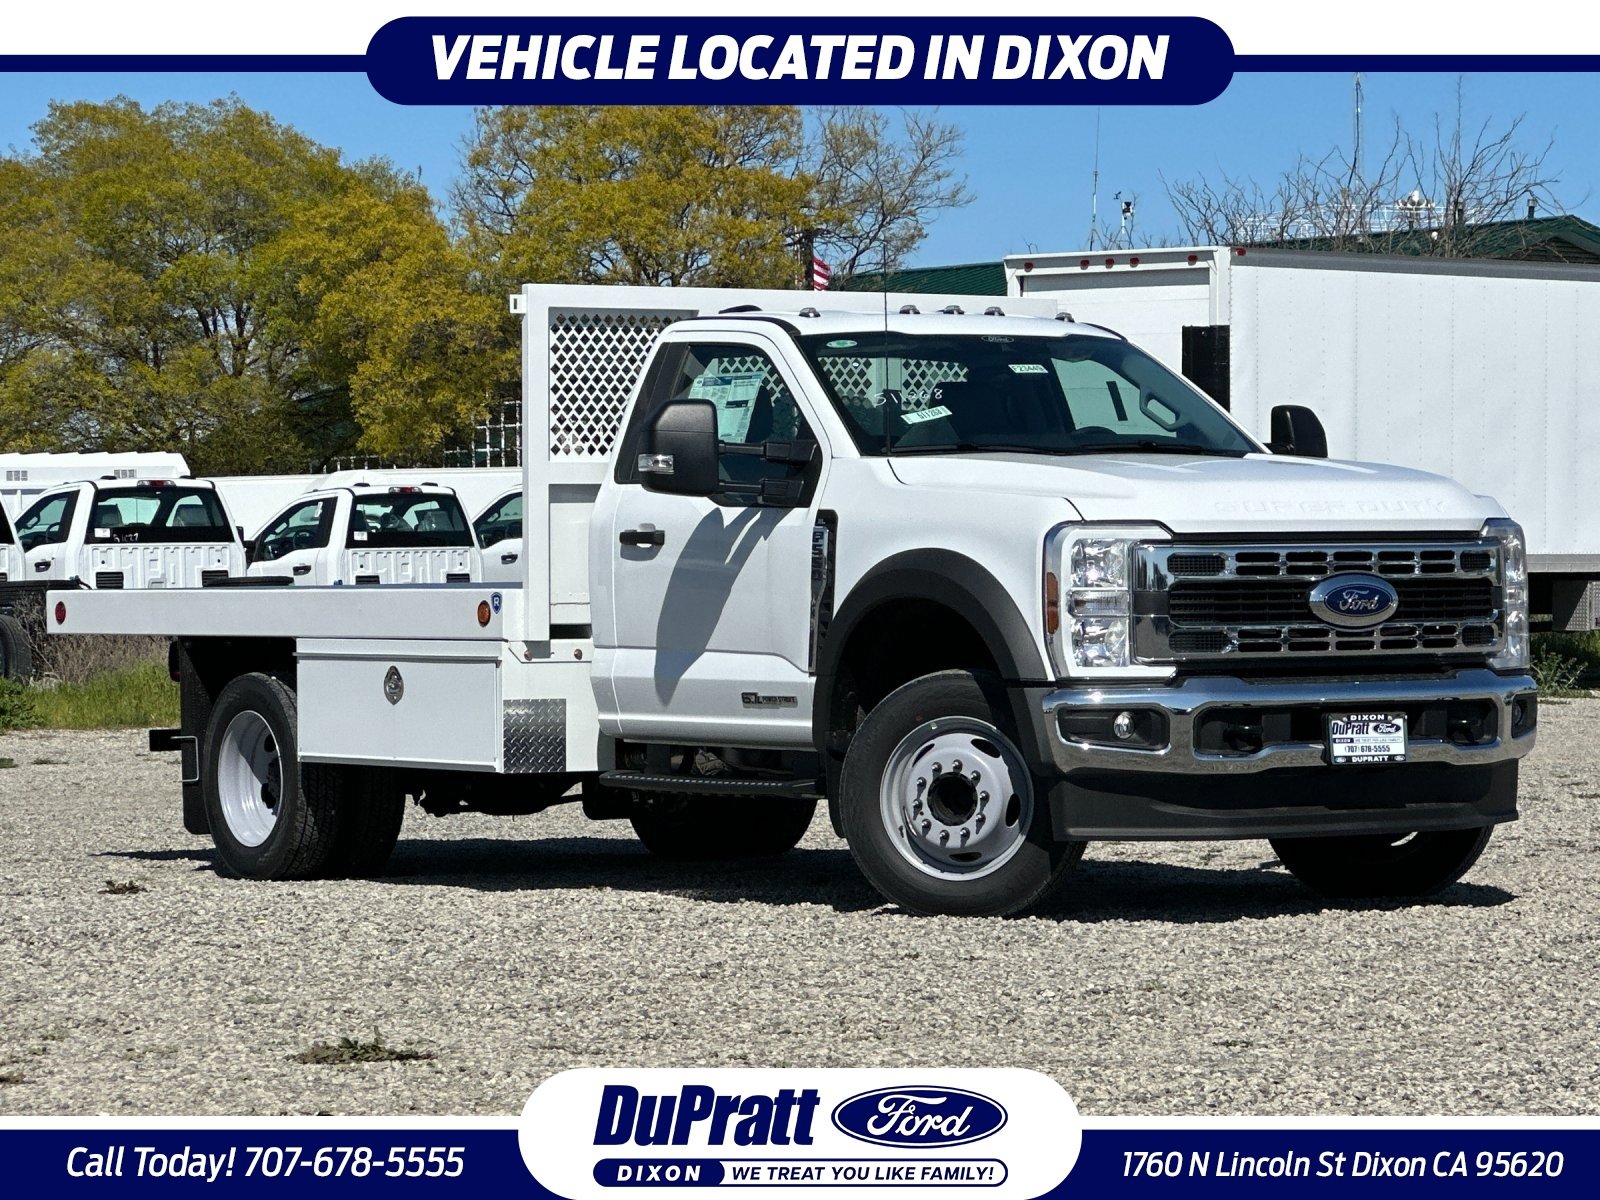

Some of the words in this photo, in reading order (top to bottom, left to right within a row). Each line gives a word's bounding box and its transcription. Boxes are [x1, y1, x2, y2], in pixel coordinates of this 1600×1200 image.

[1338, 589, 1380, 612] Ford
[1332, 722, 1370, 735] DuPratt
[1377, 723, 1397, 734] Ford
[1360, 745, 1391, 753] 678-5555
[1351, 755, 1389, 763] DUPRATT
